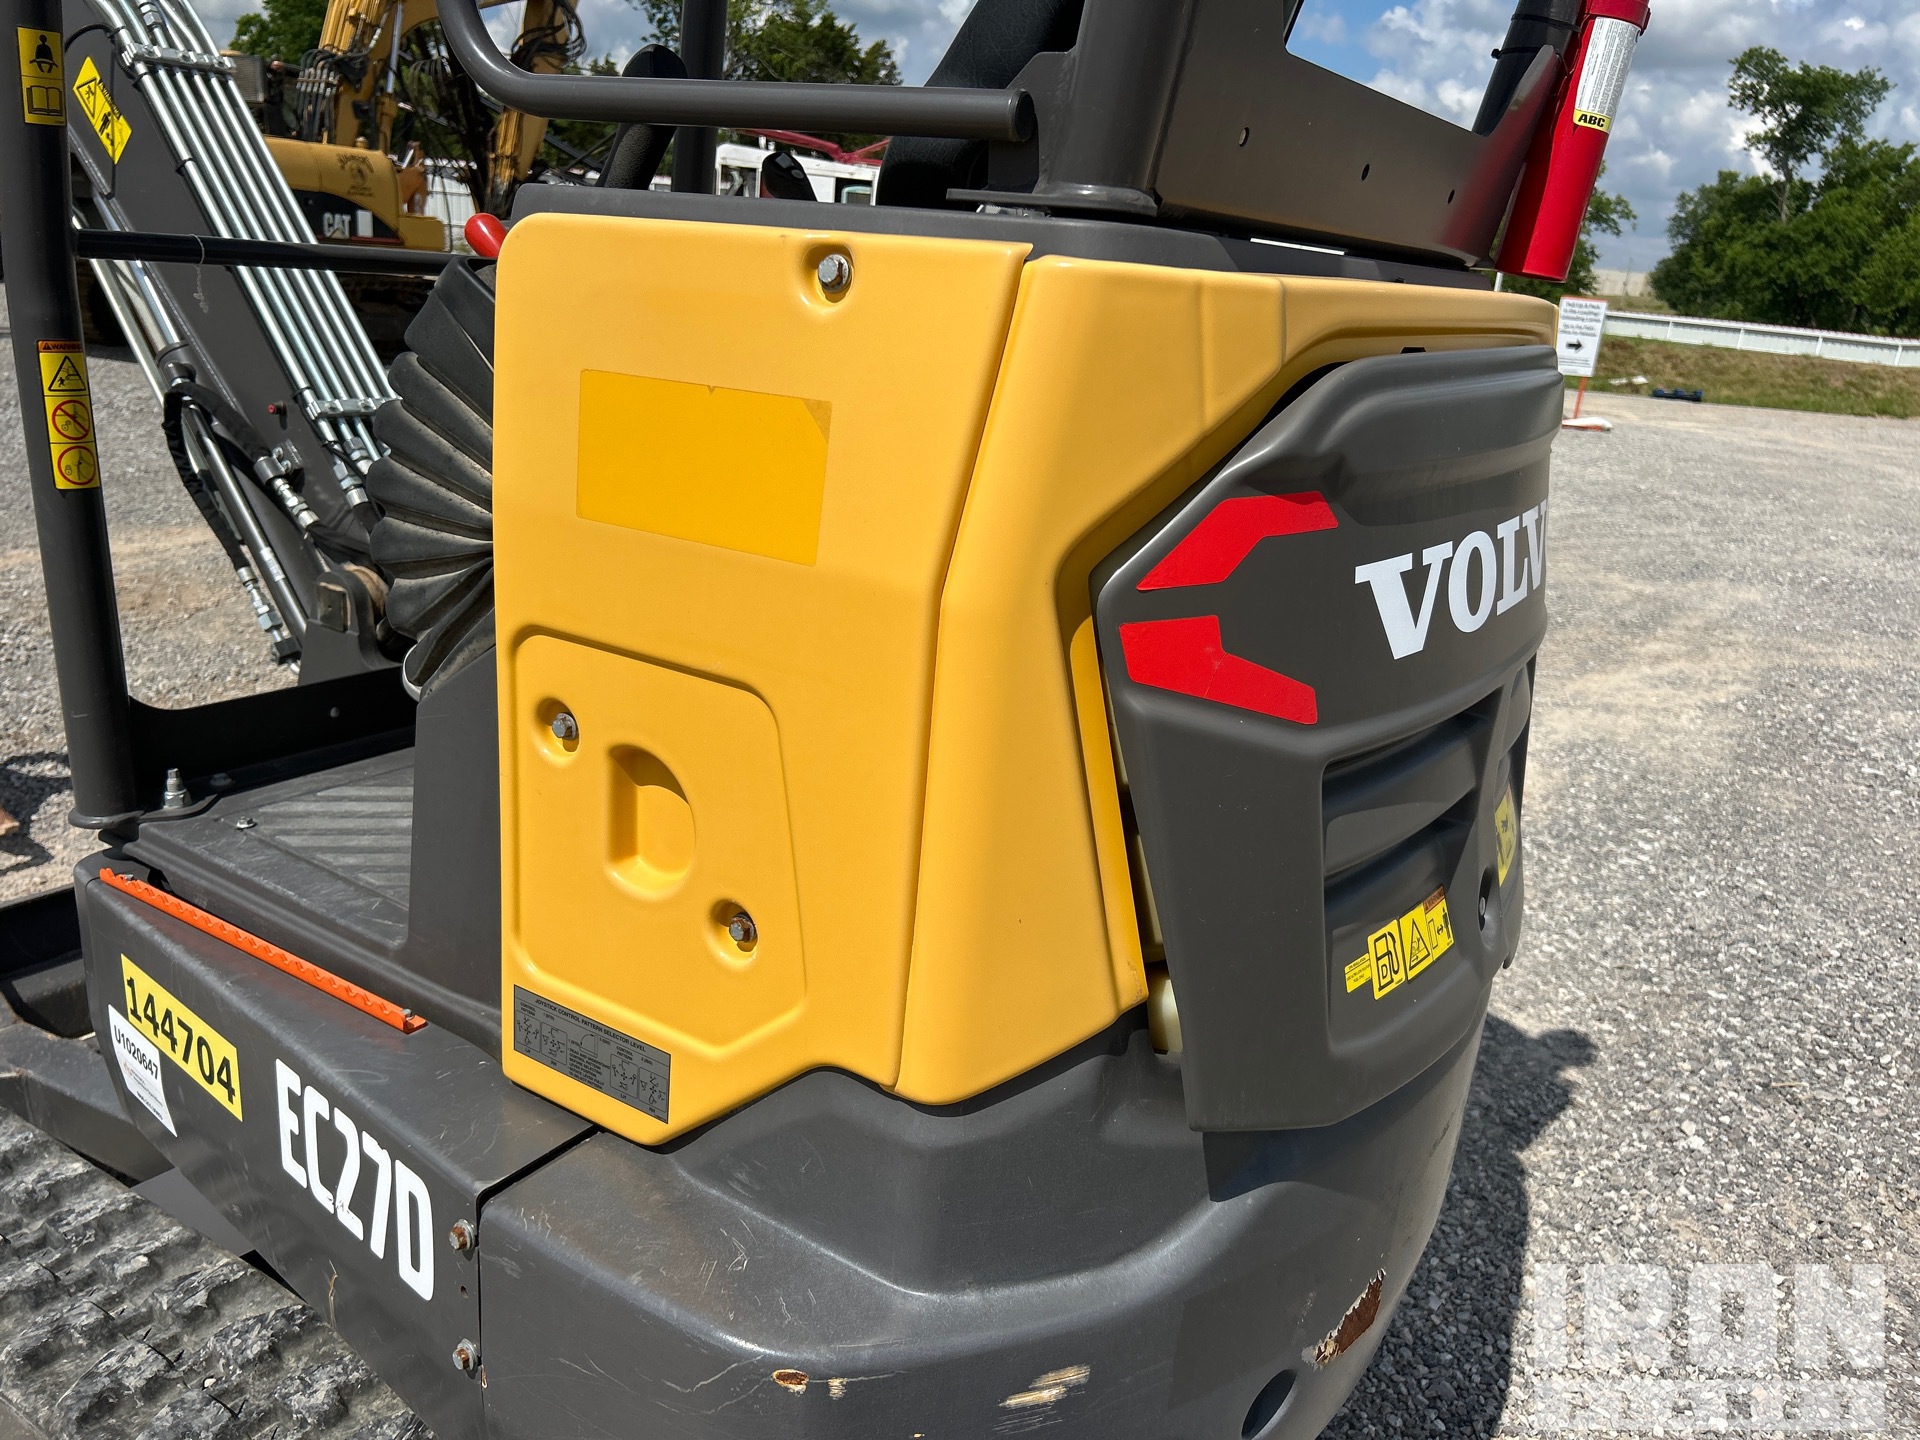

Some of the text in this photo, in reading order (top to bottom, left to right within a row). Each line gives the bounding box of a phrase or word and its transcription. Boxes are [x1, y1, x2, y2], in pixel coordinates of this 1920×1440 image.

[1577, 113, 1606, 128] ABC
[323, 211, 351, 239] CAT
[126, 977, 236, 1105] 144704
[535, 999, 557, 1012] JOYSTICK
[558, 1009, 580, 1023] CONTROL
[582, 1020, 603, 1033] PATTERN
[604, 1030, 629, 1045] SELECTOR
[114, 1024, 159, 1080] U1020647
[275, 1058, 434, 1301] EC27D
